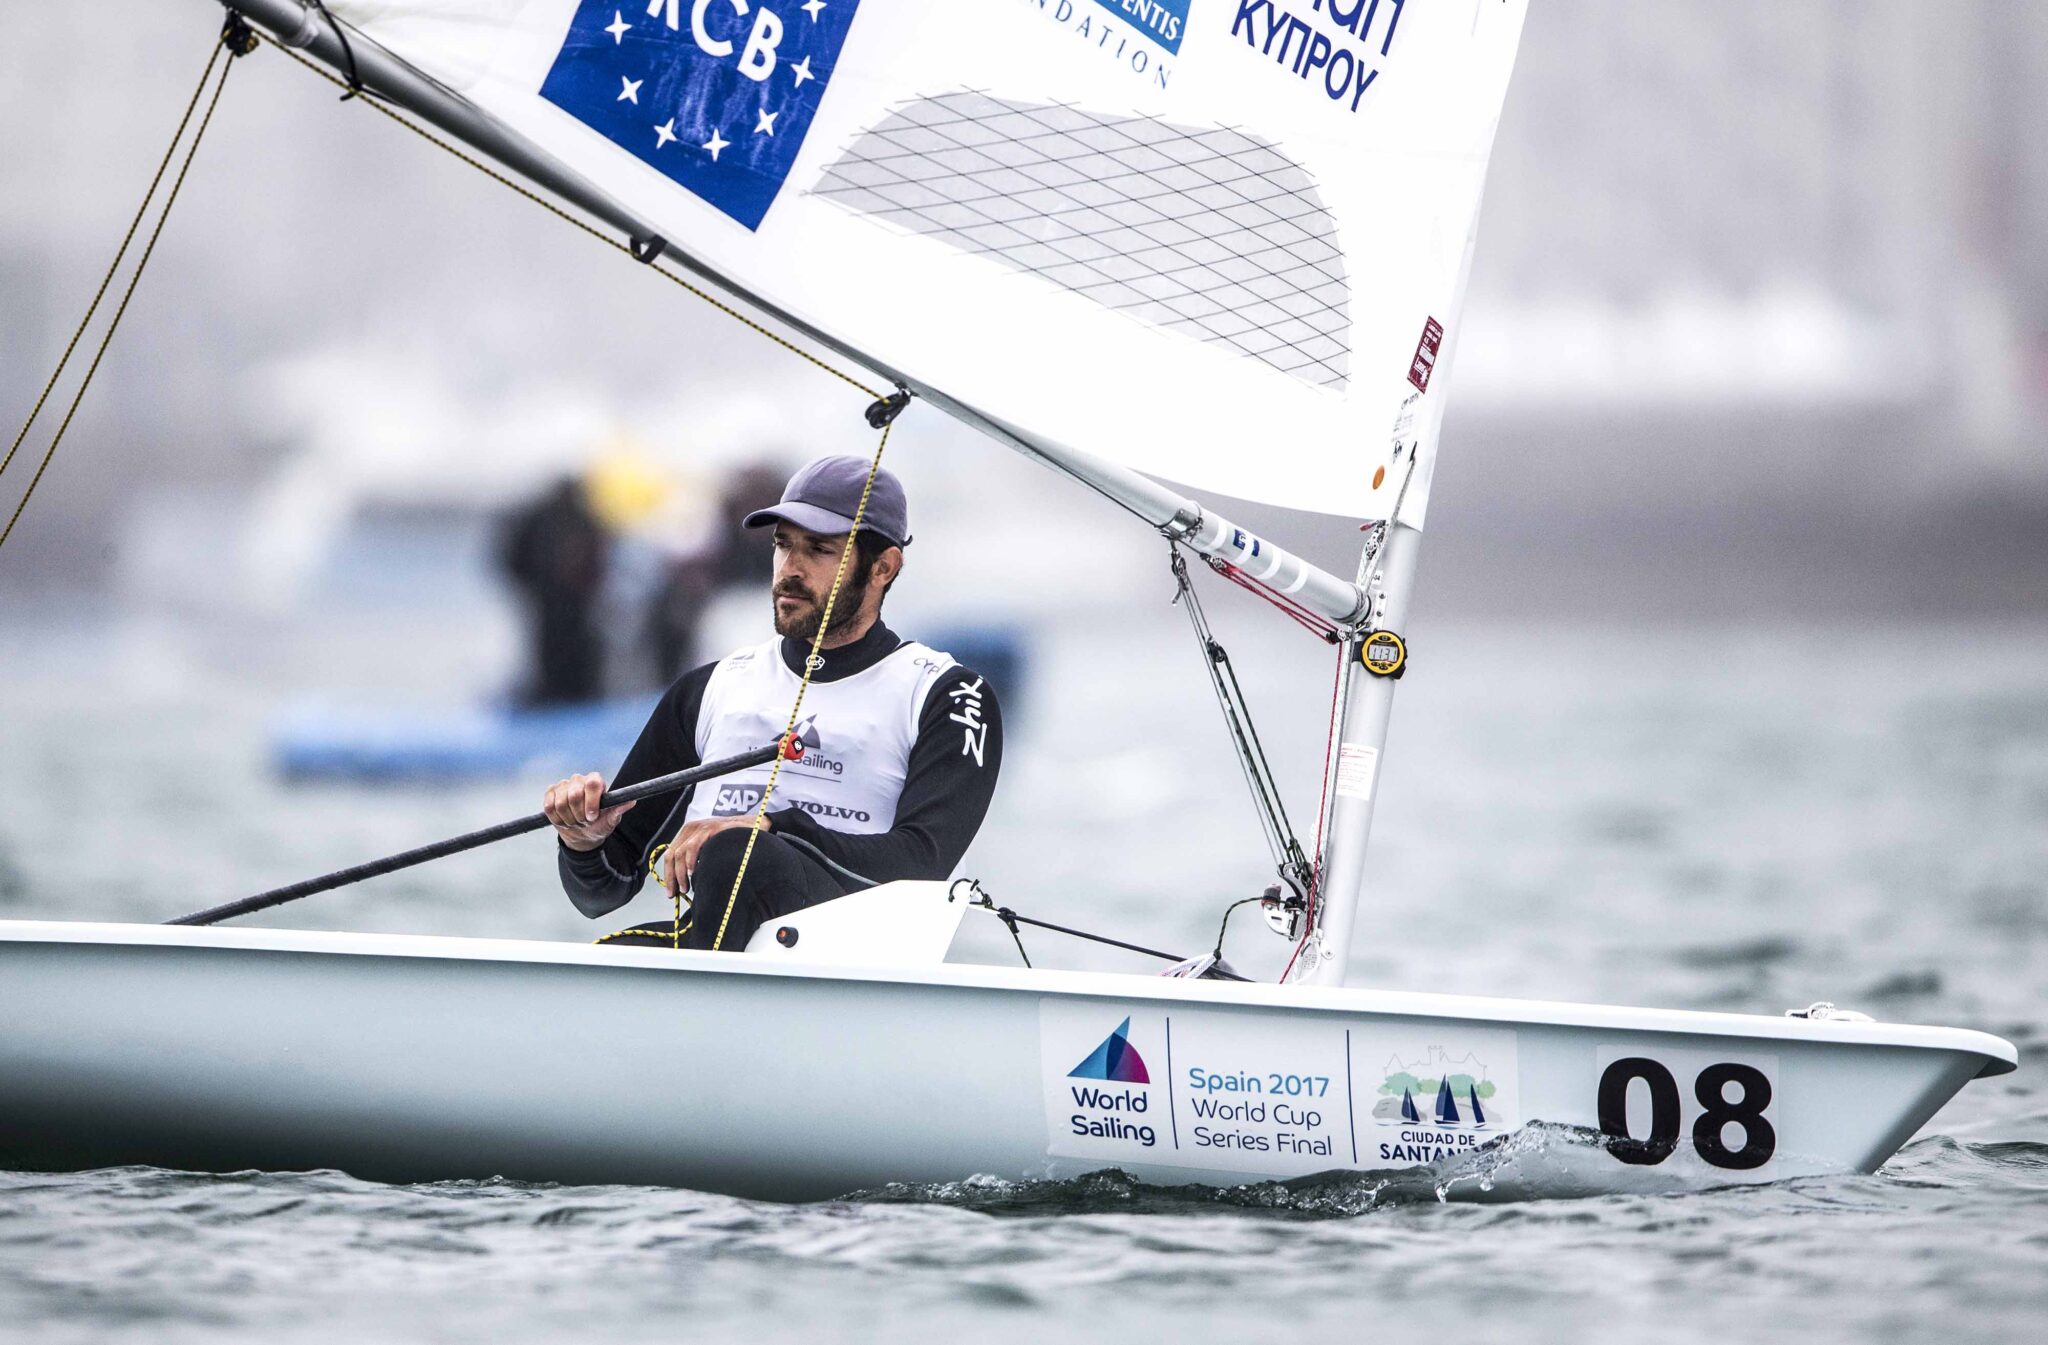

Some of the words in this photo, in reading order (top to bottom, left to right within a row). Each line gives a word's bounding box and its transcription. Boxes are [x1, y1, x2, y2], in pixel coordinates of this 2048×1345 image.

[1111, 0, 1181, 40] NTIS
[949, 677, 987, 767] Zhik
[715, 789, 759, 812] SAP
[788, 800, 870, 822] VOLVO
[1189, 1068, 1261, 1095] Spain
[1269, 1073, 1329, 1097] 2017
[1071, 1086, 1148, 1113] World
[1597, 1057, 1776, 1170] 08
[1191, 1098, 1266, 1123] World
[1273, 1104, 1322, 1131] Cup
[1071, 1114, 1156, 1147] Sailing
[1194, 1126, 1270, 1151] Series
[1276, 1133, 1332, 1156] Final
[1401, 1130, 1454, 1145] CIUDAD
[1458, 1134, 1476, 1146] DE
[1380, 1143, 1473, 1162] SANTA
